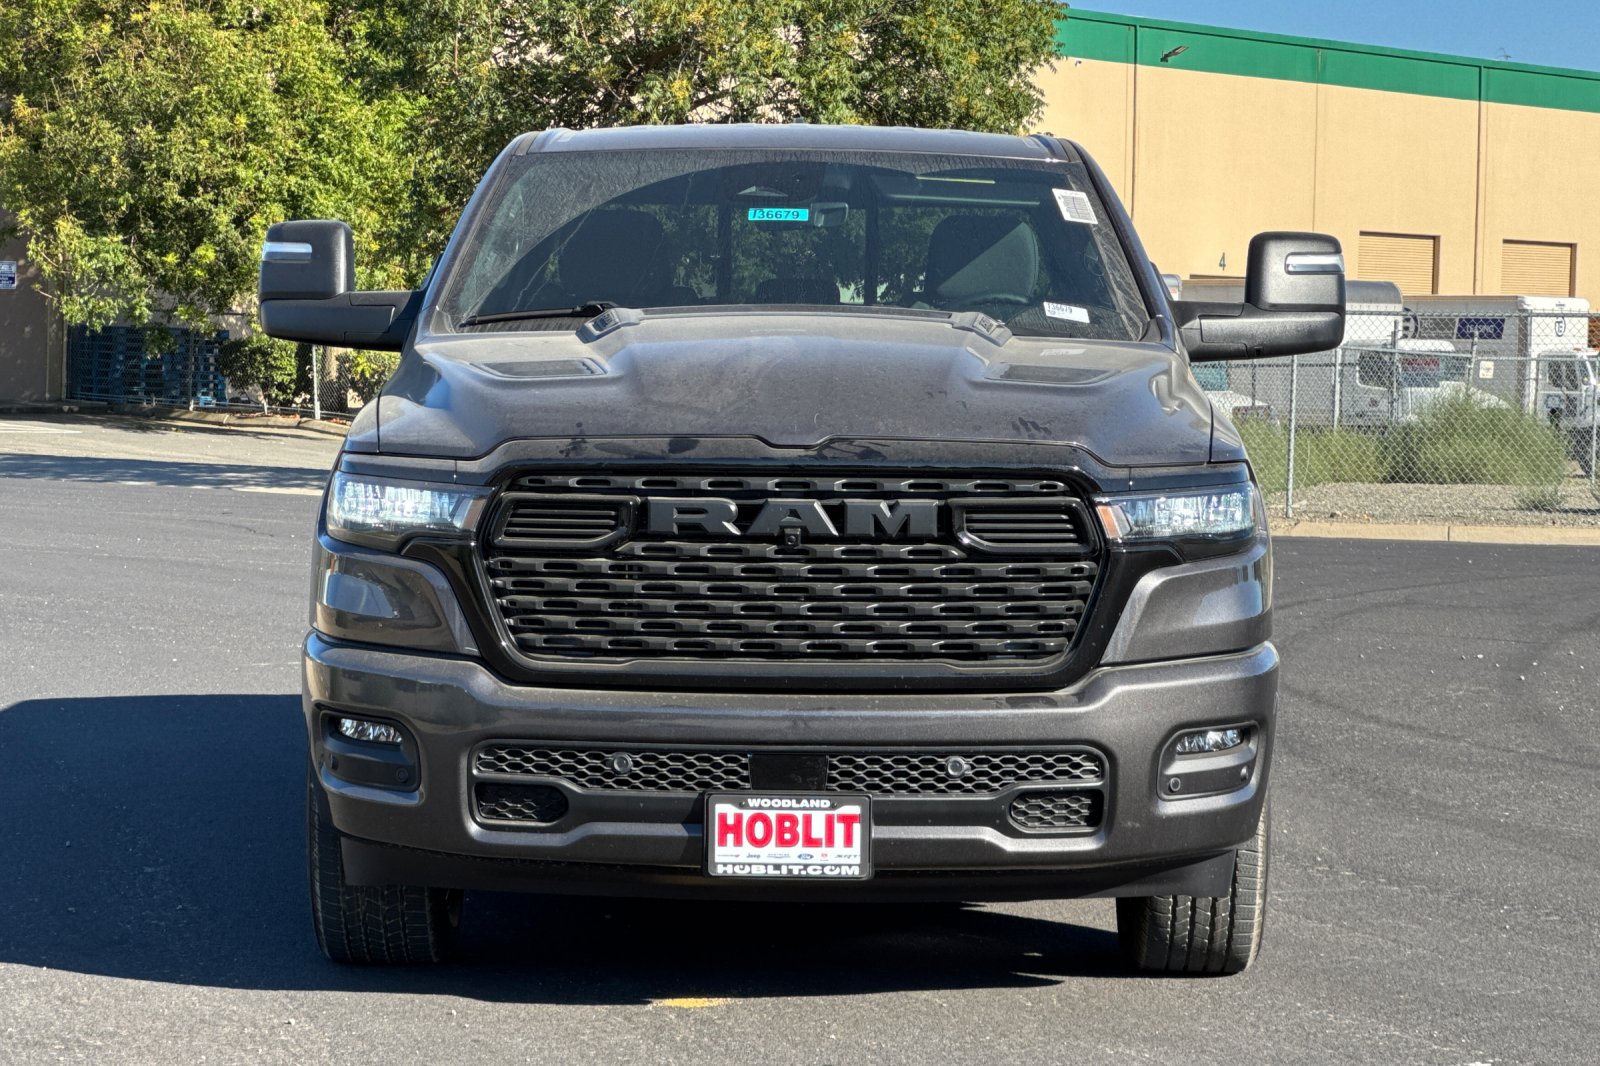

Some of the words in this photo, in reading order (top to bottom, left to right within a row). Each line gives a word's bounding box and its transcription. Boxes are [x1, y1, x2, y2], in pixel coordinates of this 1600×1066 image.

[1219, 251, 1227, 271] 4
[648, 497, 938, 537] RAM
[747, 798, 831, 808] WOODLAND
[717, 812, 861, 848] HOBLIT
[716, 864, 860, 876] HOBLIT.COM
